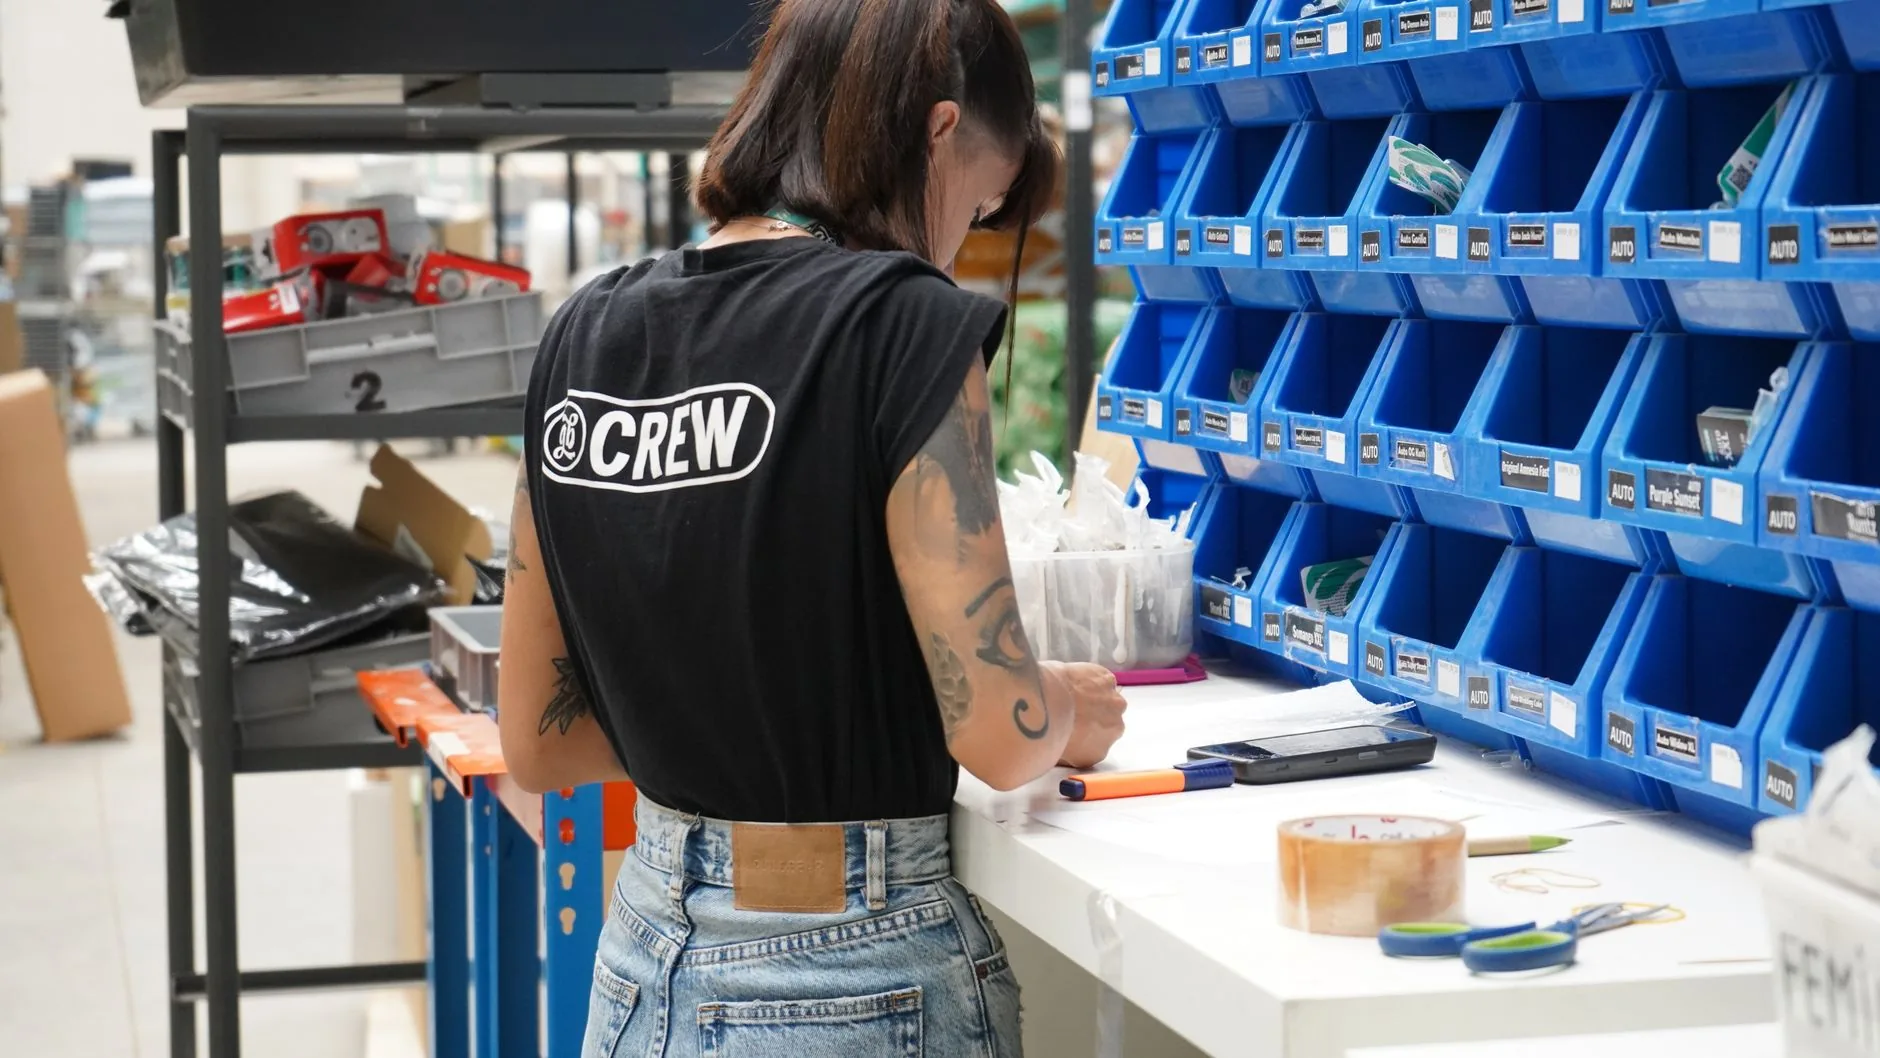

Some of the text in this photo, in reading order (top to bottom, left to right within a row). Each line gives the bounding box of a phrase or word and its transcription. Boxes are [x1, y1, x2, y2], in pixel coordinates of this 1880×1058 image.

[1473, 9, 1493, 26] AUTO
[1365, 33, 1382, 48] AUTO
[1265, 43, 1281, 58] AUTO
[1177, 55, 1191, 71] AUTO
[1400, 233, 1427, 244] Auto Gorilla
[1660, 231, 1675, 243] Auto
[1177, 239, 1190, 251] AUTO
[1268, 239, 1283, 252] AUTO
[1363, 242, 1379, 257] AUTO
[1471, 241, 1489, 256] AUTO
[1611, 242, 1634, 257] AUTO
[1770, 241, 1798, 259] AUTO
[351, 370, 387, 412] 2
[1178, 419, 1191, 432] AUTO
[589, 395, 751, 480] CREW
[1267, 432, 1281, 446] AUTO
[1362, 445, 1379, 459] AUTO
[1398, 446, 1408, 456] Auto
[1408, 447, 1415, 457] OG
[1501, 460, 1519, 475] Original
[1519, 462, 1539, 477] Amnesia
[1612, 483, 1634, 502] AUTO
[1649, 484, 1701, 510] Purple Sunset
[1768, 511, 1796, 530] AUTO
[1266, 624, 1280, 637] AUTO
[1292, 624, 1314, 646] Somango
[1313, 632, 1324, 648] XXL
[1367, 653, 1384, 671] AUTO
[1470, 690, 1488, 705] AUTO
[1610, 726, 1633, 748] AUTO
[1656, 733, 1669, 747] Auto
[1766, 775, 1793, 801] AUTO
